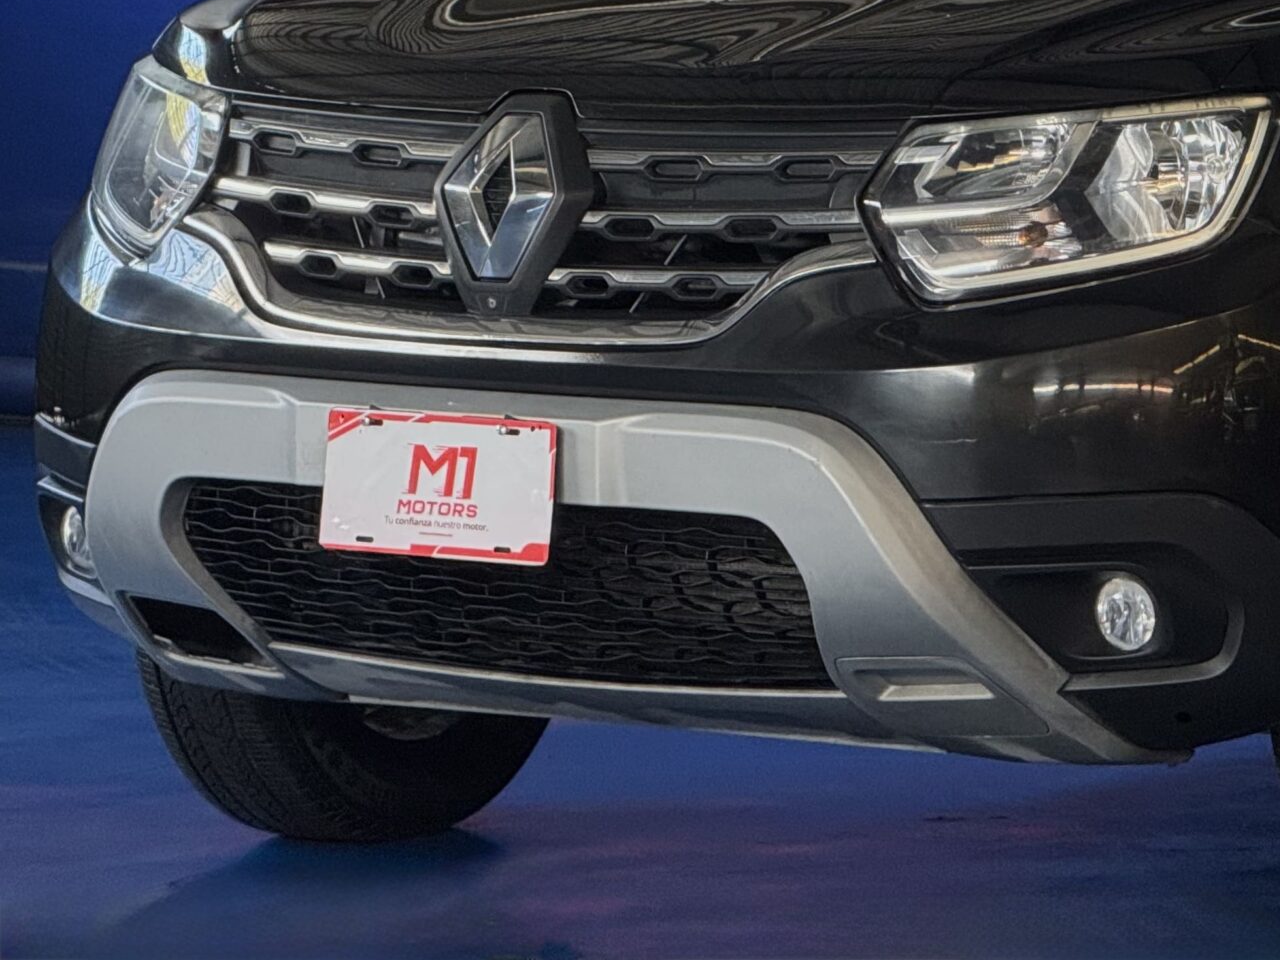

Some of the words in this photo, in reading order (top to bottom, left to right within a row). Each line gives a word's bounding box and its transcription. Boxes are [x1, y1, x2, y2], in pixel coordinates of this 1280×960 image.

[406, 443, 478, 500] M1
[396, 499, 479, 519] MOTORS
[384, 515, 394, 525] Tu
[395, 517, 433, 528] confianza
[433, 520, 462, 530] nuestro
